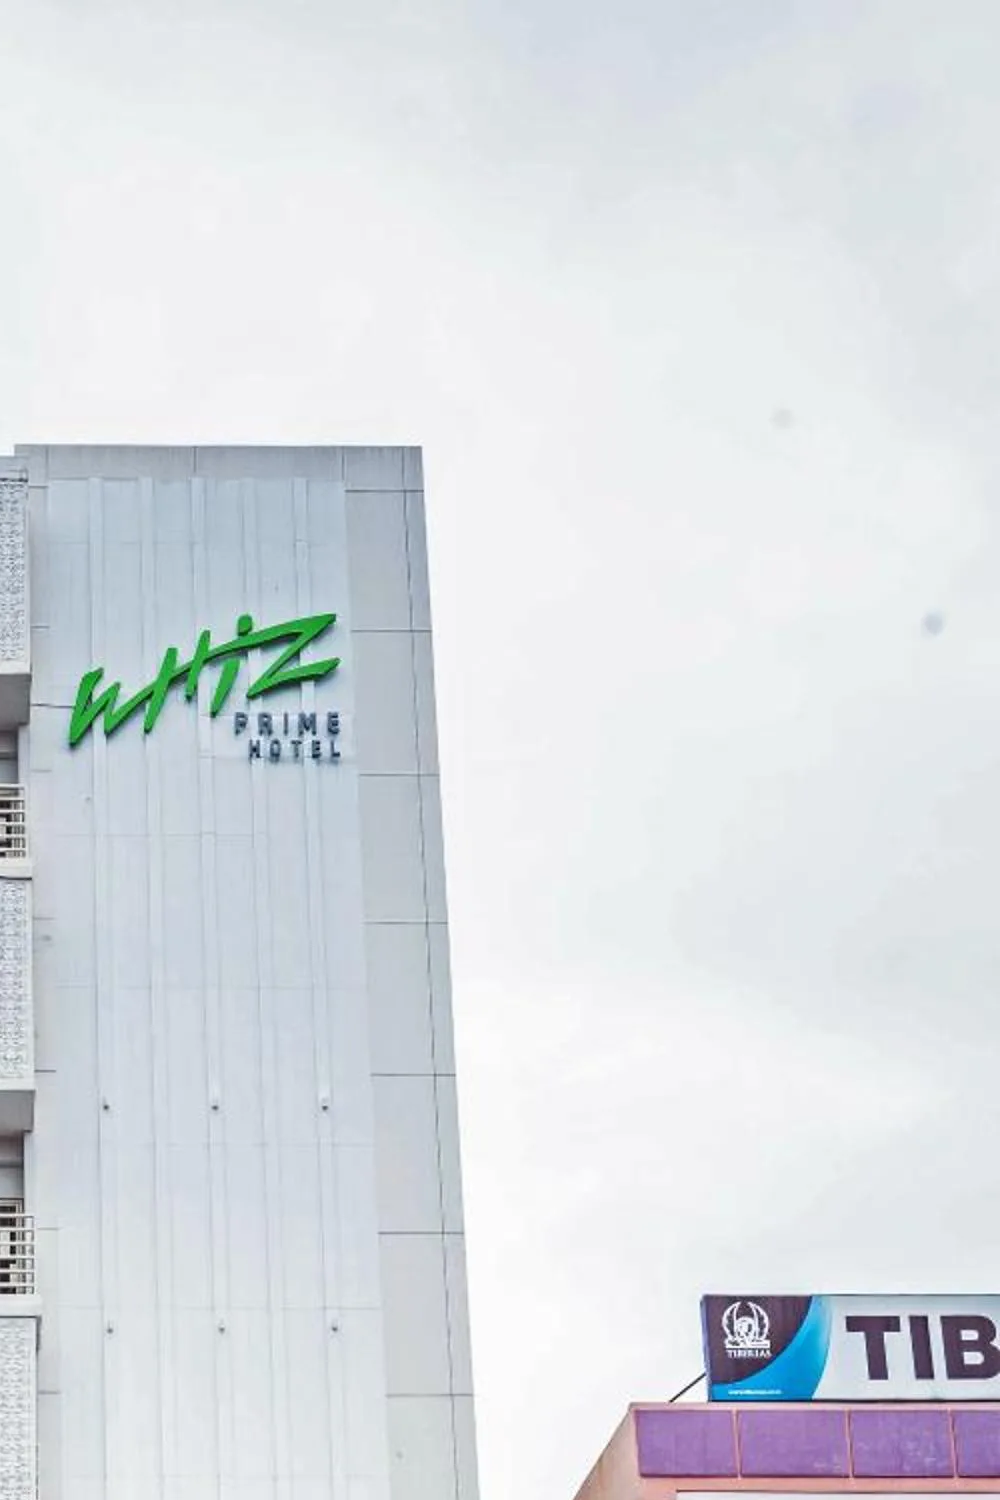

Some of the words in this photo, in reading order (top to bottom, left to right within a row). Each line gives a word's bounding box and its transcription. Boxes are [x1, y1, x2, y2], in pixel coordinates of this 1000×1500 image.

[234, 712, 339, 736] PRIME
[249, 739, 340, 759] HOTEL
[845, 1315, 1000, 1380] TIB
